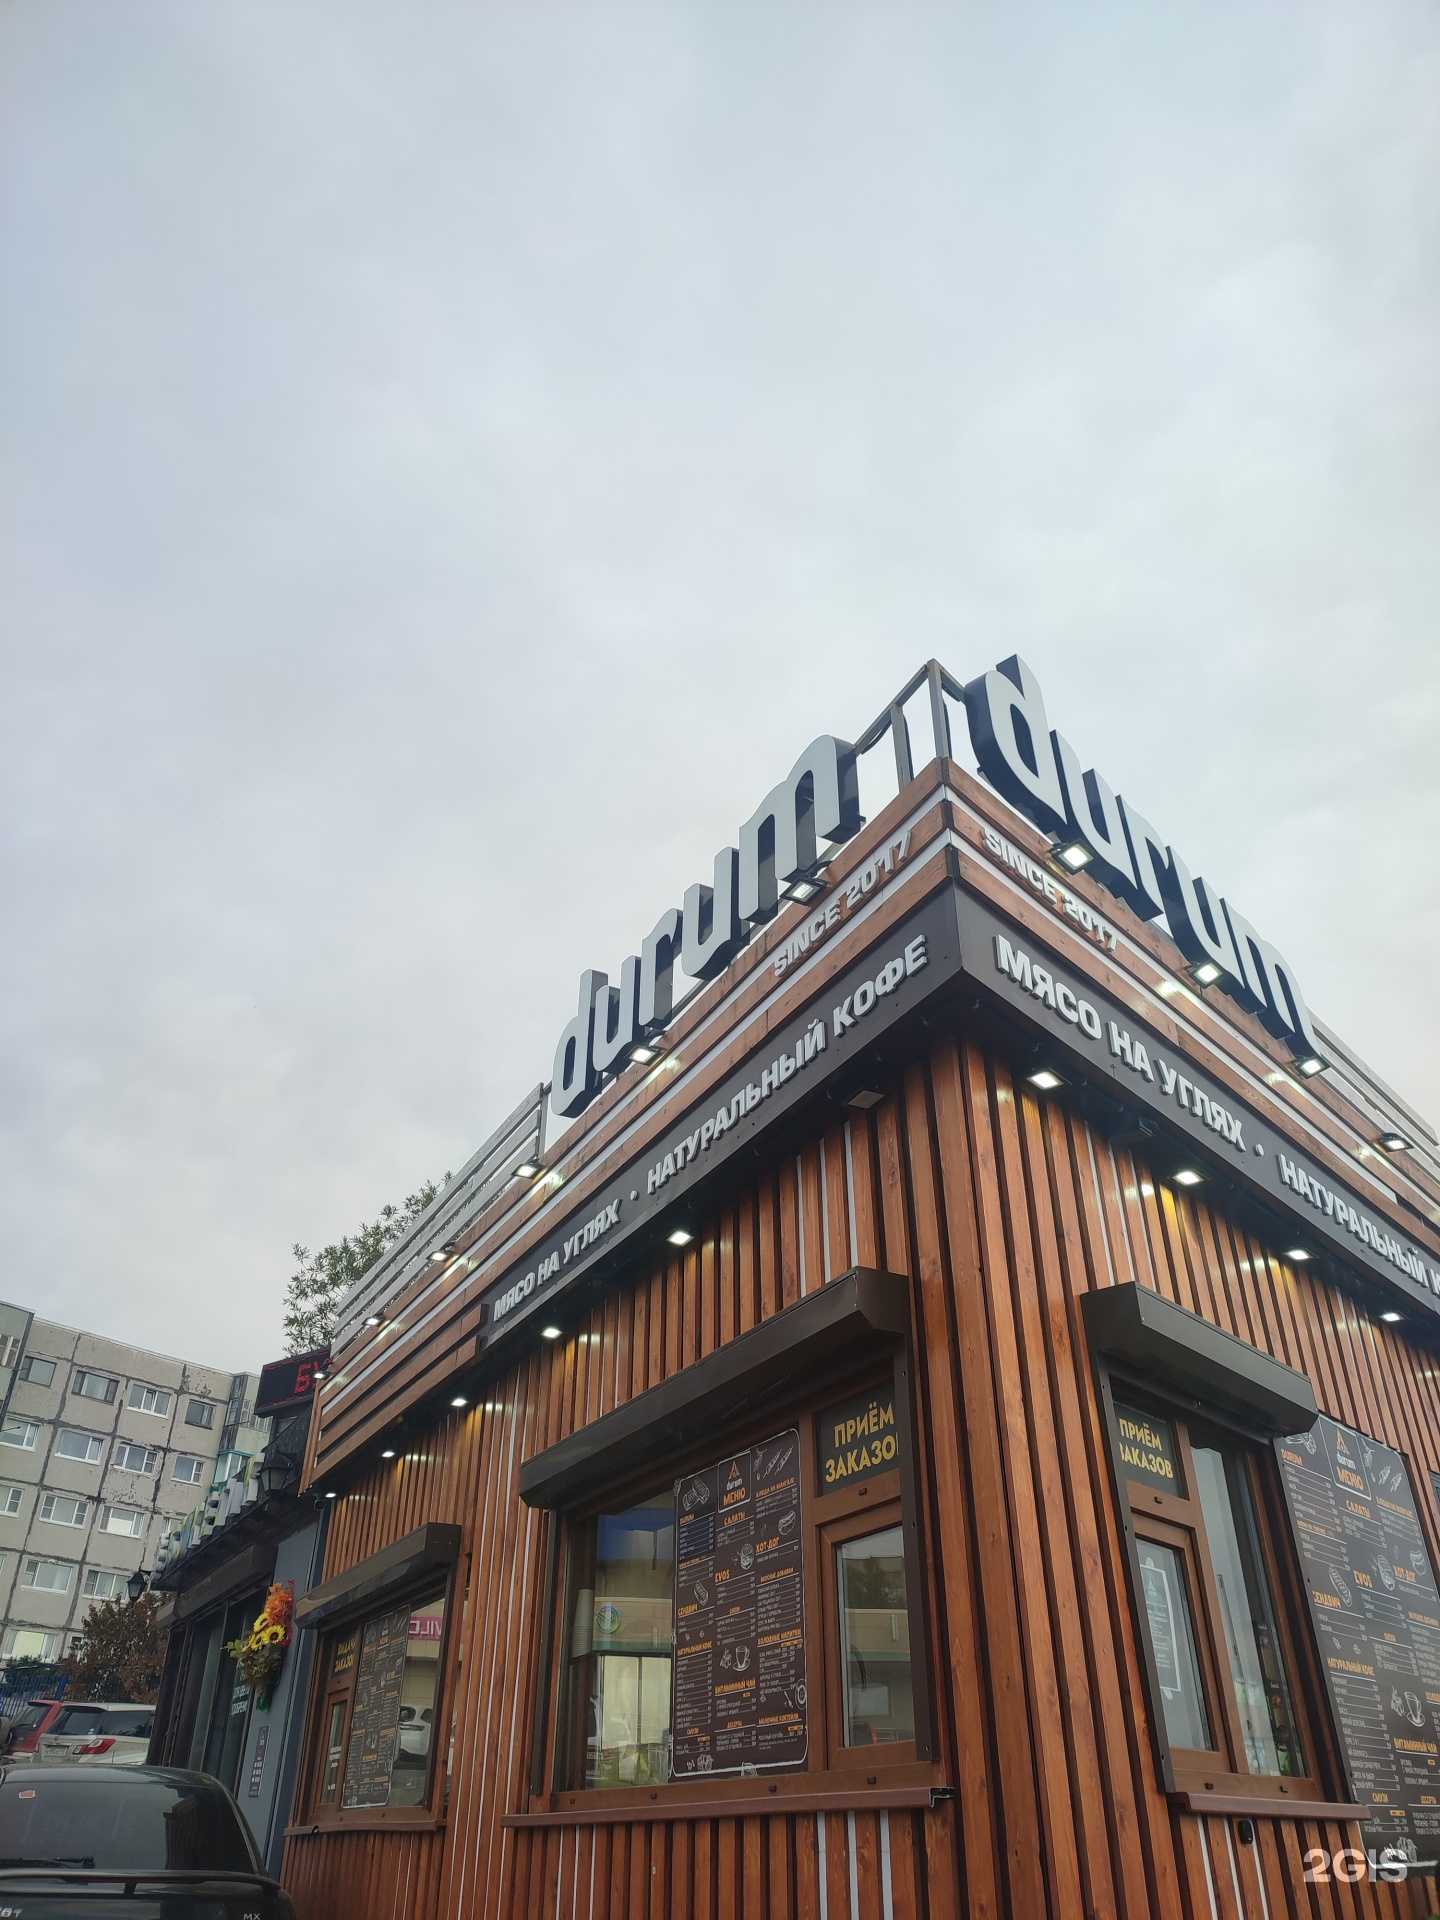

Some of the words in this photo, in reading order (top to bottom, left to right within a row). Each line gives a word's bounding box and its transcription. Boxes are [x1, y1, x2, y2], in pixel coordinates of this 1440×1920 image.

[773, 902, 841, 977] SINCE
[846, 829, 912, 909] 2017
[966, 654, 1324, 1057] durum
[983, 827, 1059, 905] SINCE
[1061, 895, 1118, 952] 2017
[550, 734, 860, 1118] durum
[493, 1272, 535, 1322] МЯСО
[537, 1250, 560, 1286] НА
[563, 1199, 622, 1264] УГЛЯХ
[647, 1018, 826, 1193] НАТУРАЛЬНЫЙ
[832, 934, 928, 1037] КОФЕ
[994, 934, 1102, 1040] МЯСО
[1107, 1021, 1156, 1083] НА
[1158, 1057, 1247, 1152] УГЛЯХ
[1278, 1153, 1430, 1289] НАТУРАЛЬНЫЙ
[825, 1432, 899, 1482] ЗАКАЗО
[834, 1401, 895, 1448] ПРИЁМ
[1119, 1418, 1162, 1451] ПРИЁМ
[723, 1487, 746, 1506] МЕНЮ
